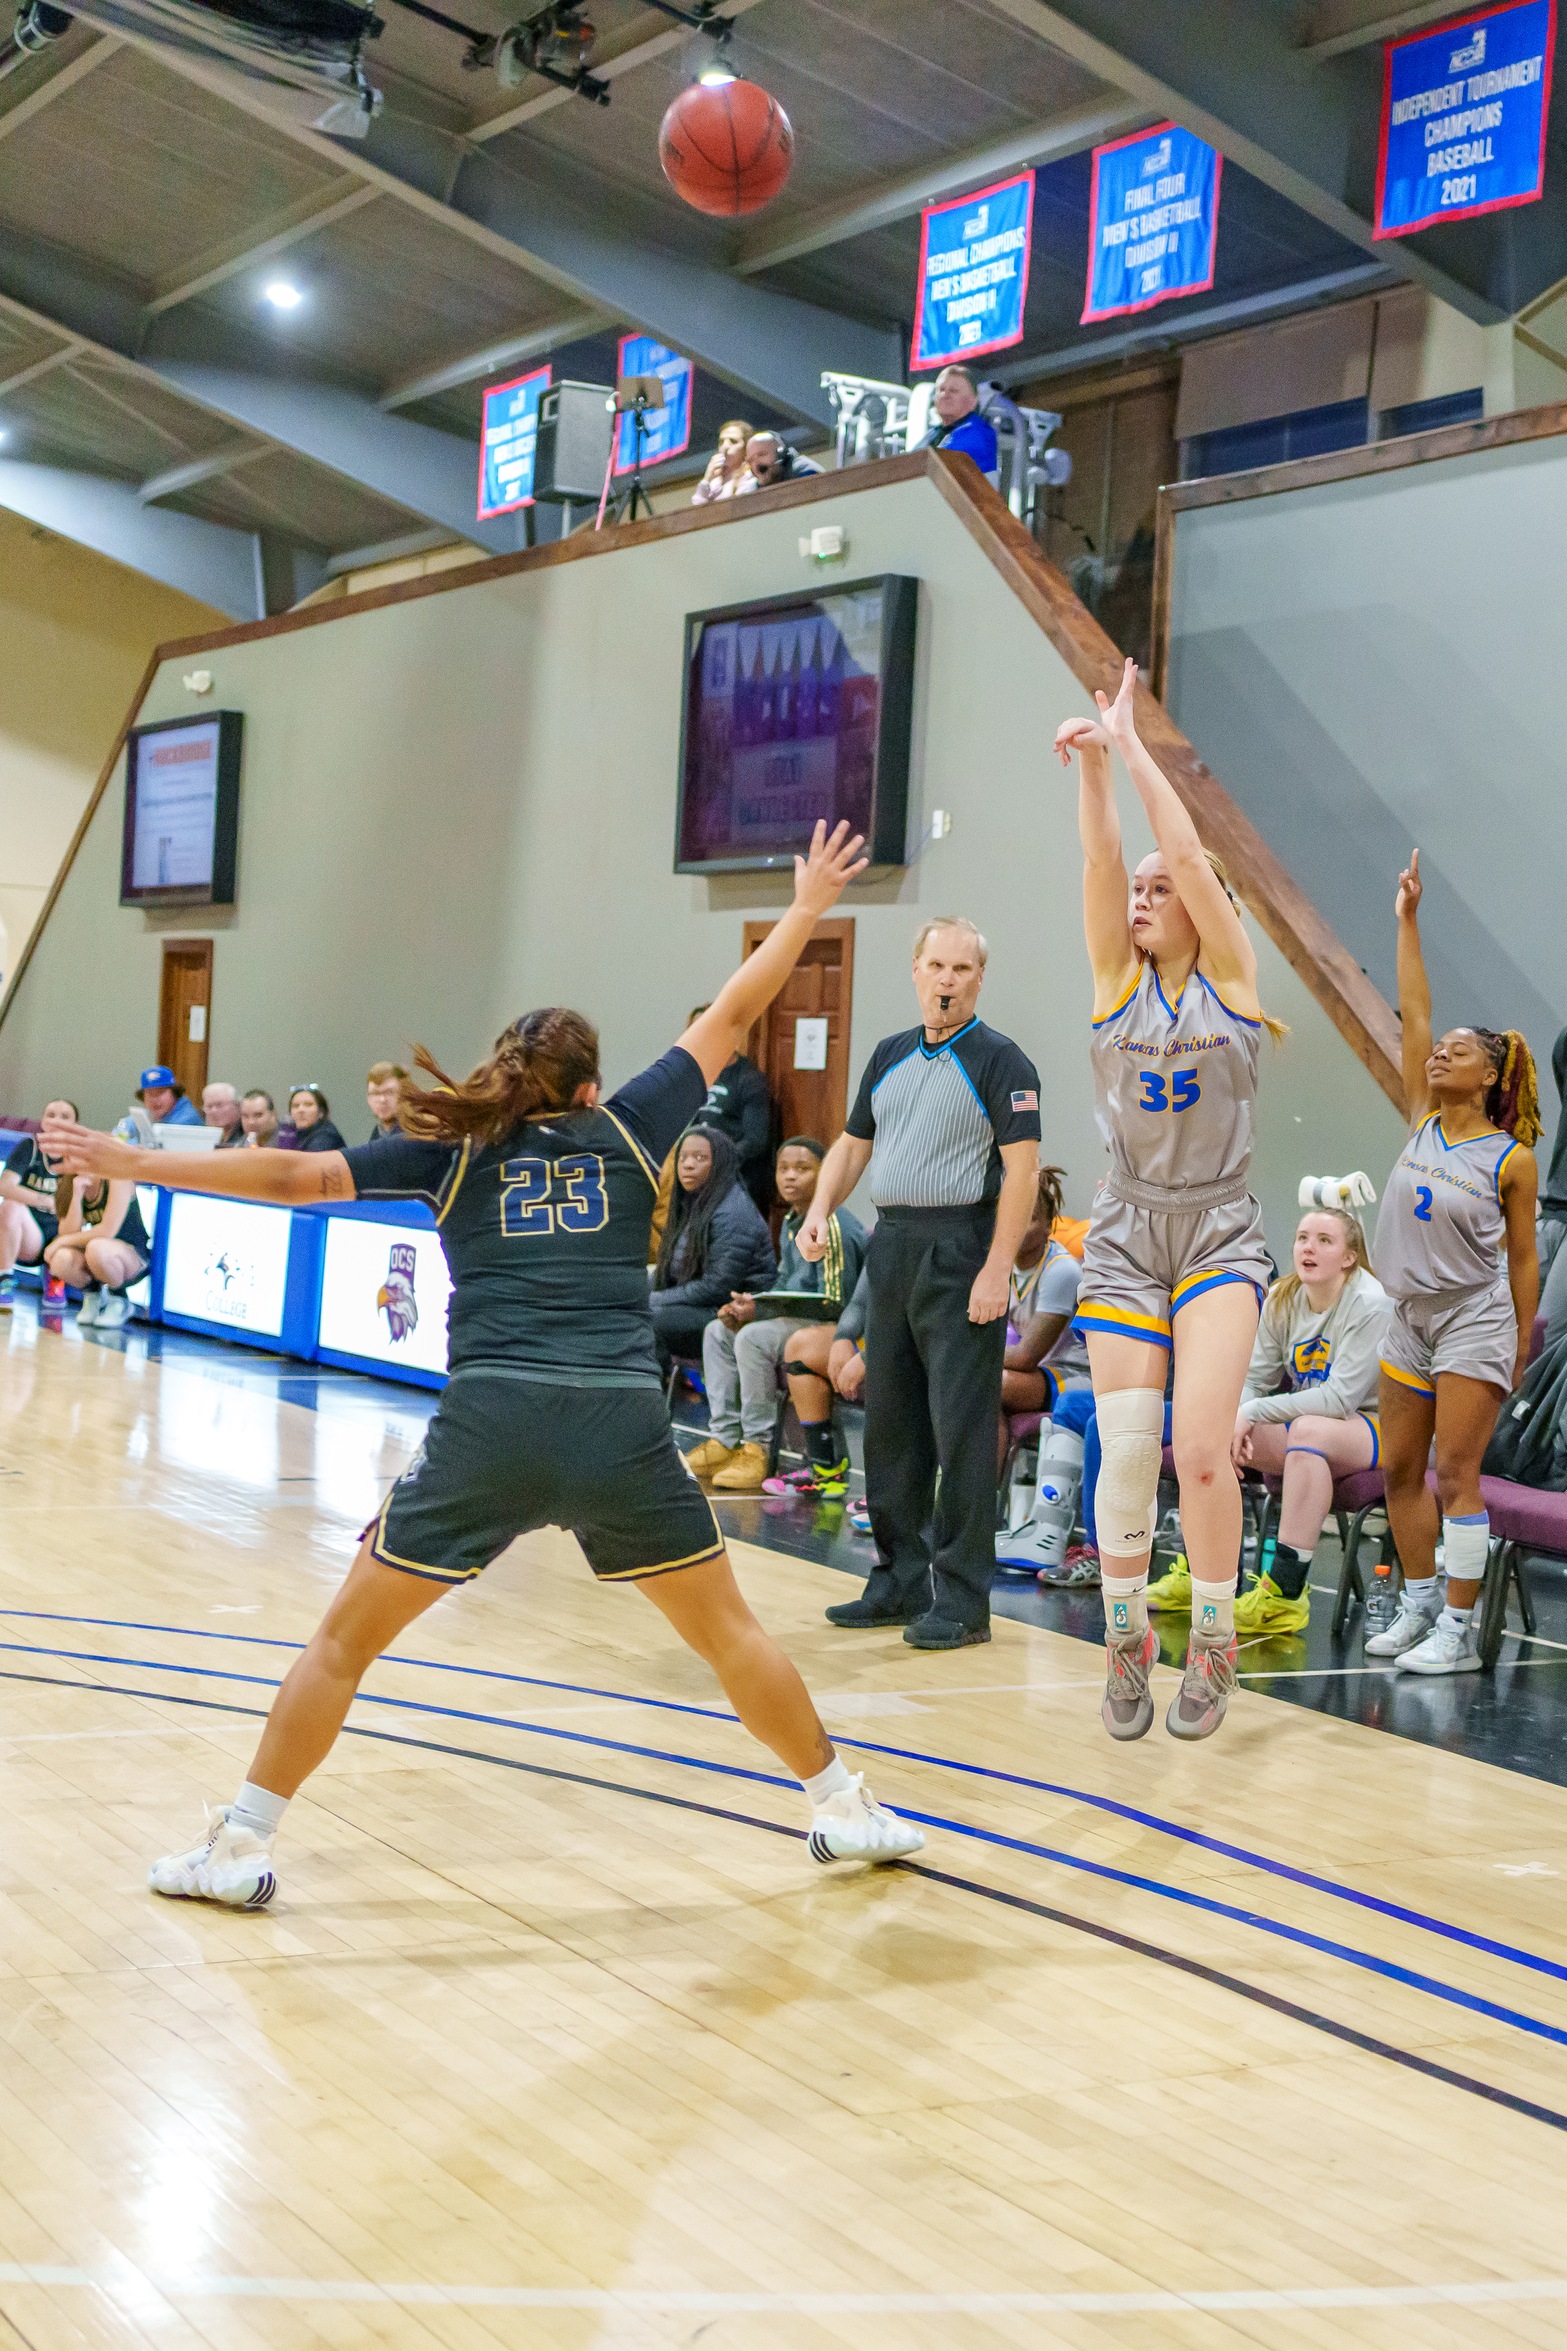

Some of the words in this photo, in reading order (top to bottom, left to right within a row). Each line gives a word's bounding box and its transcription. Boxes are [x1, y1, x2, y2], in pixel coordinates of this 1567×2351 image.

[1392, 80, 1465, 126] INDEPENDENT
[1467, 55, 1543, 101] TOURNAMENT
[1424, 101, 1503, 147] CHAMPIONS
[1427, 136, 1494, 177] BASEBALL
[1125, 184, 1155, 212] FINAL
[1156, 172, 1186, 200] FOUR
[1440, 173, 1477, 205] 2021
[1140, 196, 1201, 236] BASKETBALL
[927, 246, 970, 277] REGIONAL
[970, 226, 1025, 265] CHAMPIONS
[960, 256, 1017, 294] BASKETBALL
[1163, 1033, 1231, 1058] Christian
[1138, 1067, 1202, 1113] 35
[500, 1152, 609, 1237] 23
[1430, 1167, 1482, 1199] Christian
[1413, 1185, 1433, 1222] 2
[391, 1247, 415, 1272] OCS
[205, 1289, 248, 1320] COLLEGE
